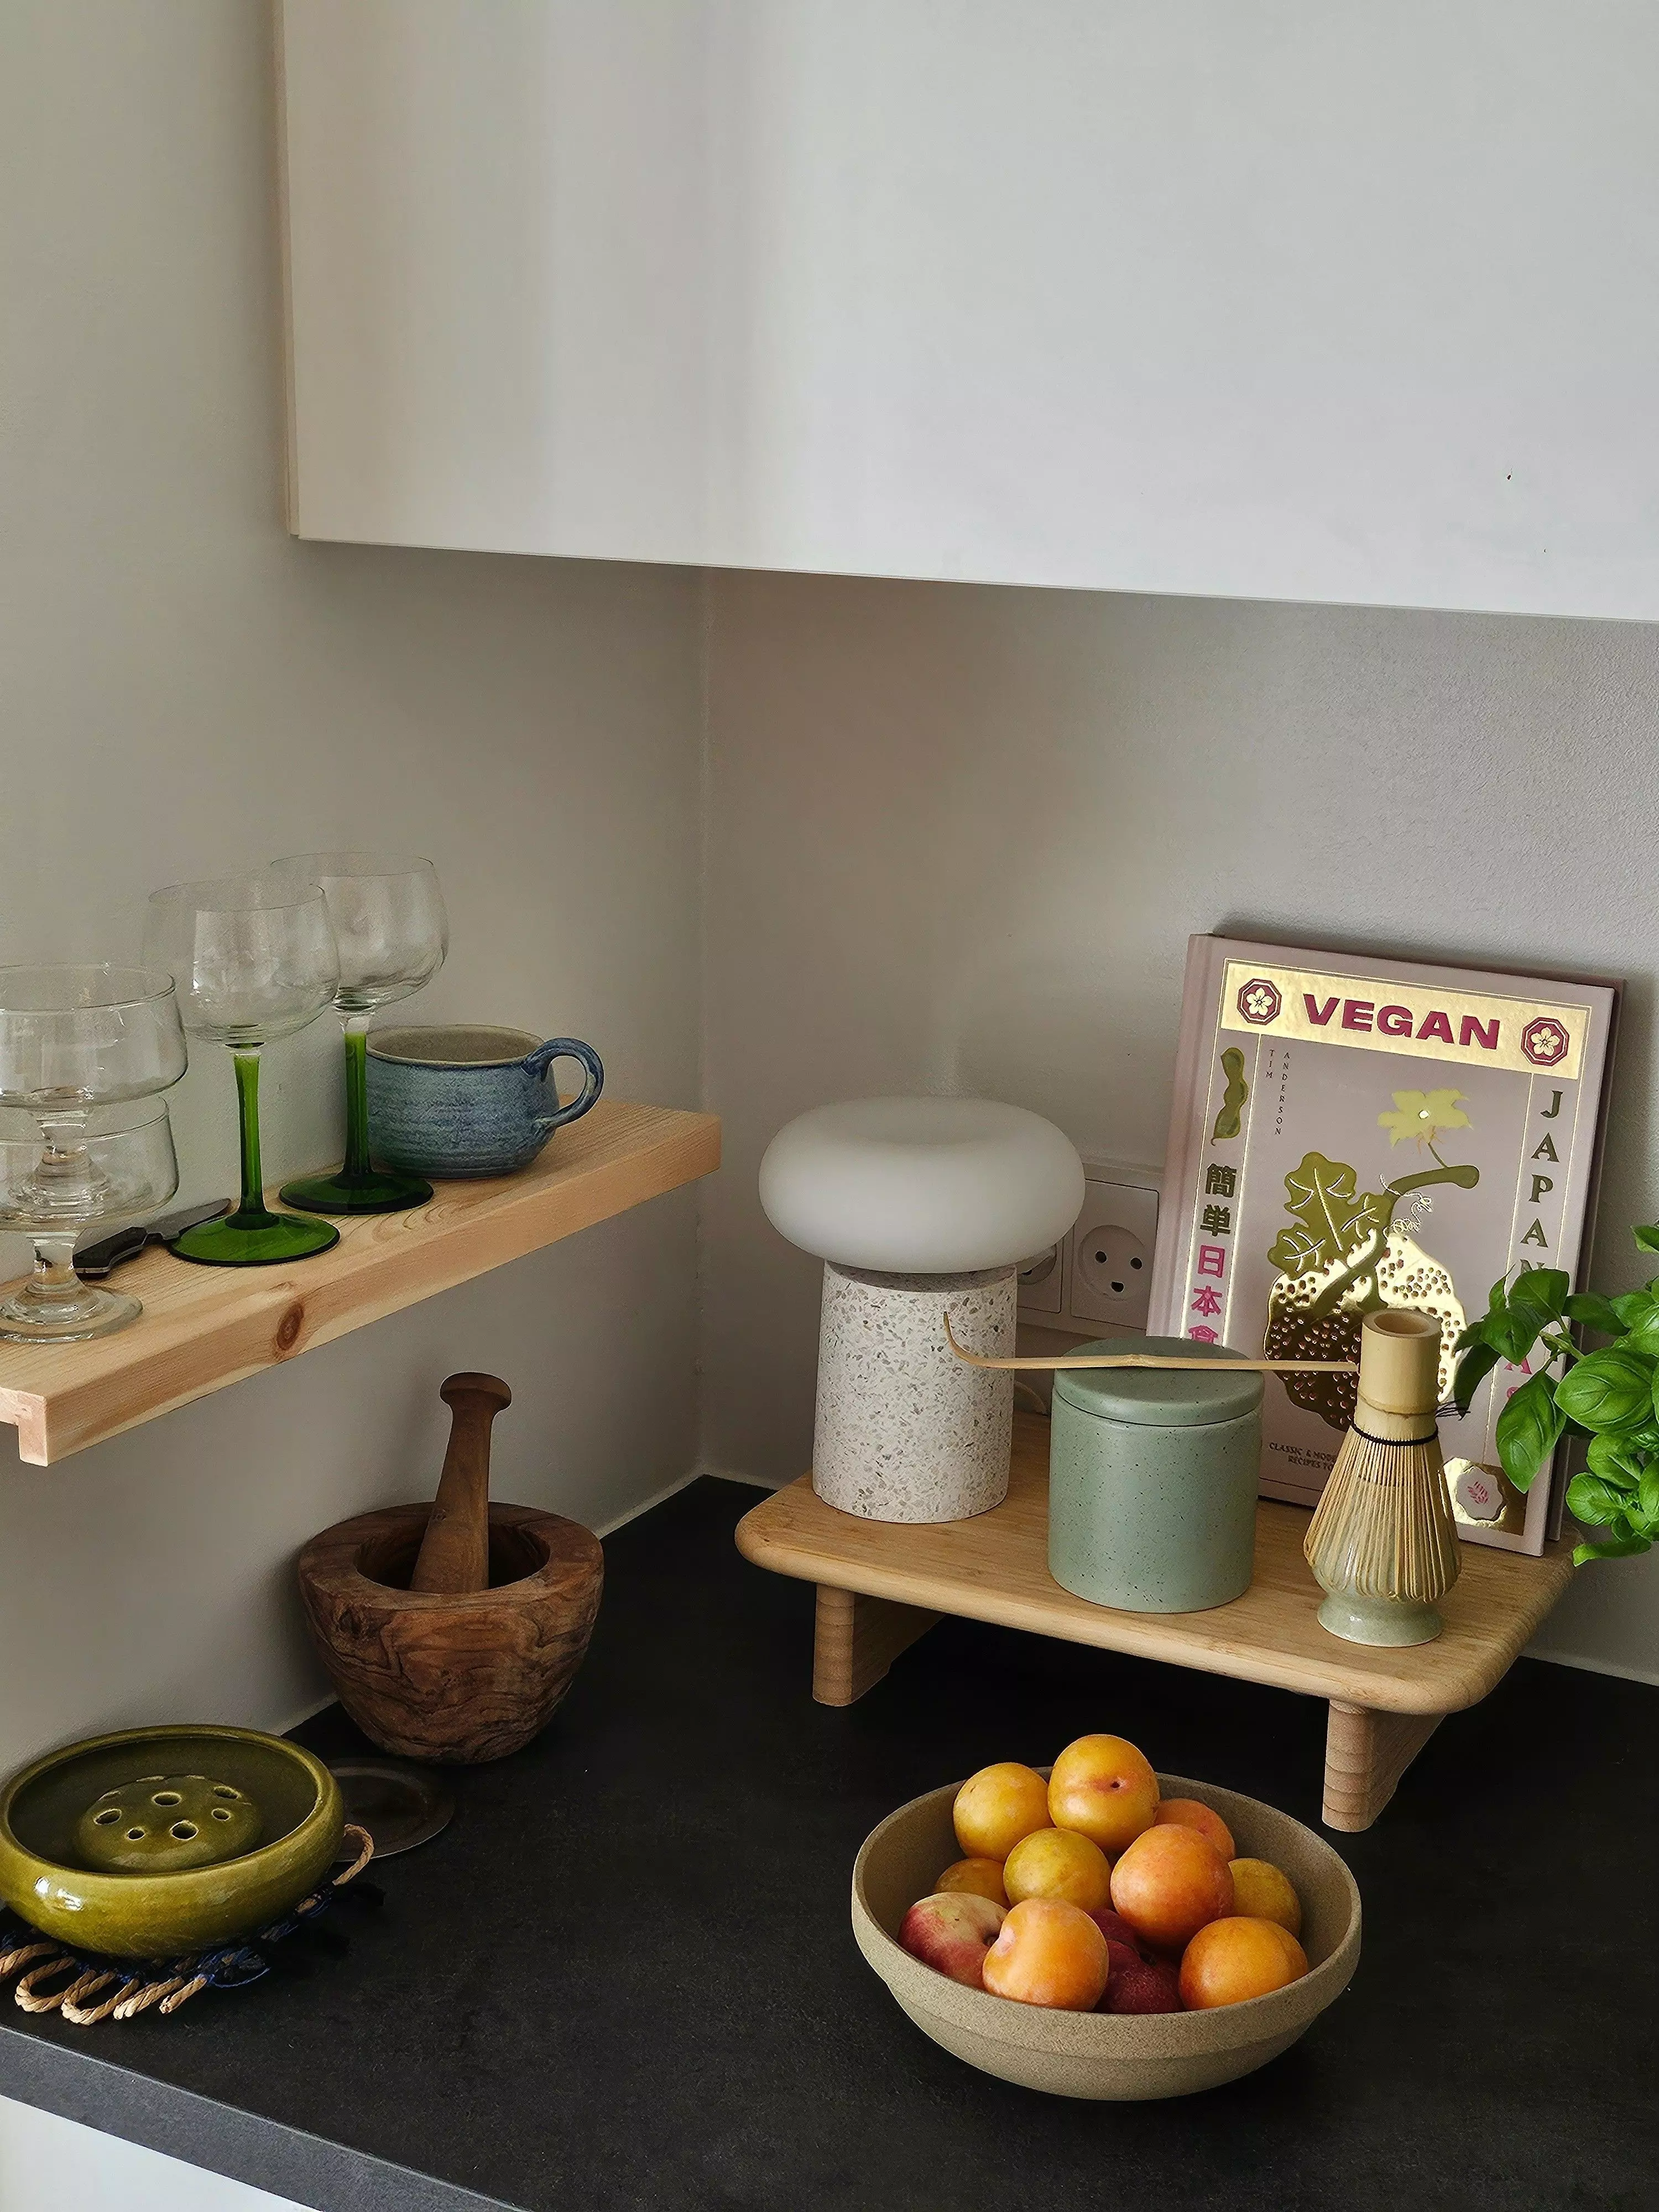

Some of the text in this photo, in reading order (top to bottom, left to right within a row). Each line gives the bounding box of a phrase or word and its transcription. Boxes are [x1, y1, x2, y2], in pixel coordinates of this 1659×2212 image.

[1302, 993, 1501, 1050] VEGAN
[1266, 1050, 1275, 1078] TIM
[1274, 1052, 1290, 1135] ANDERSON
[1269, 1442, 1303, 1456] CLASSIC
[1288, 1455, 1321, 1469] RECIPES
